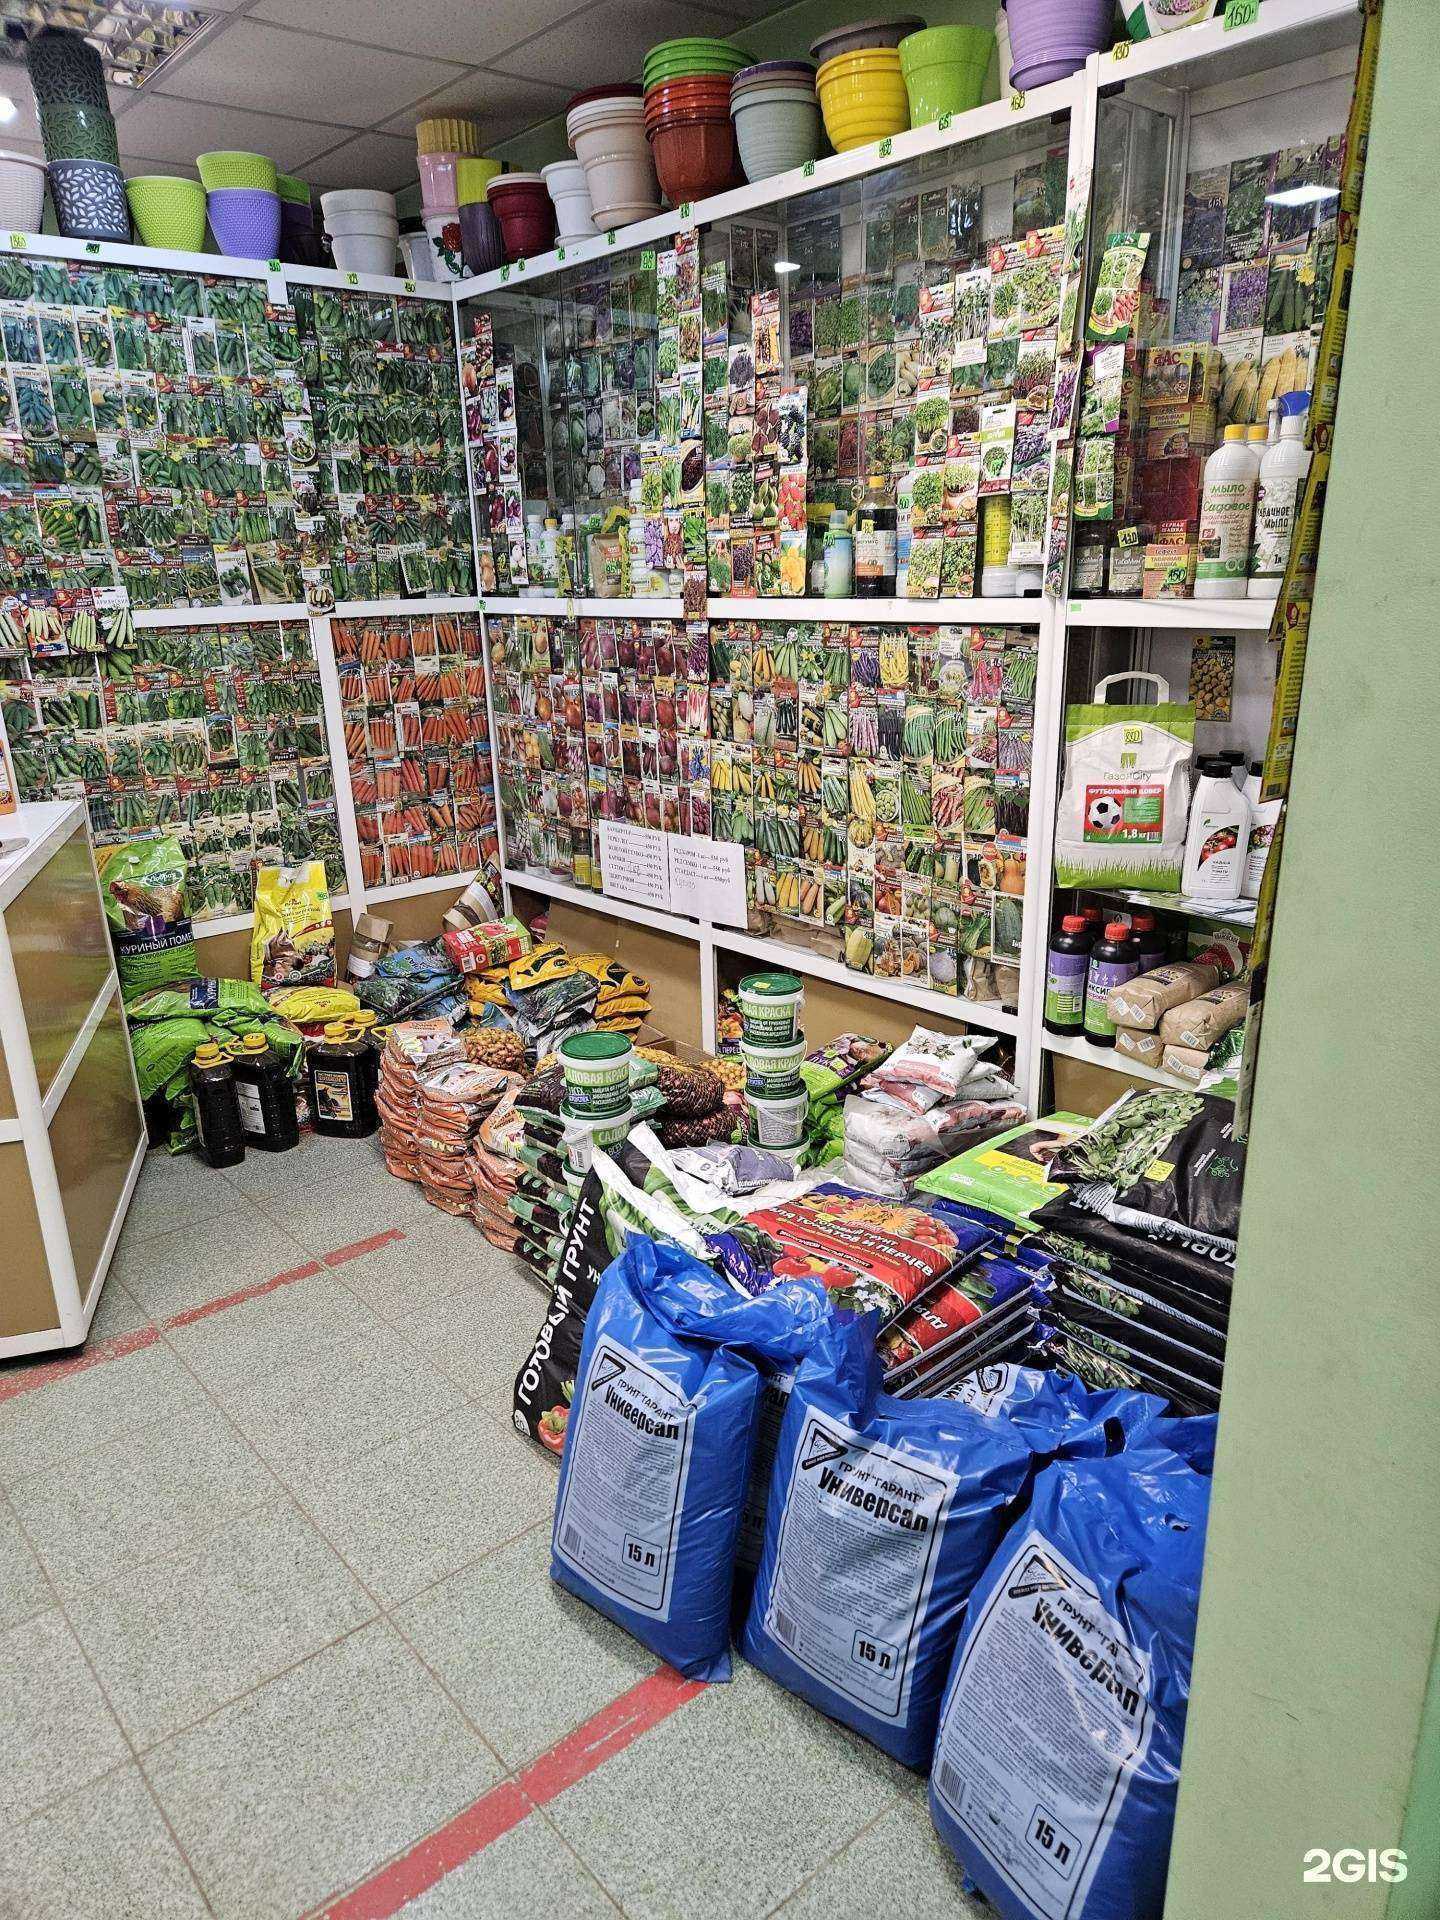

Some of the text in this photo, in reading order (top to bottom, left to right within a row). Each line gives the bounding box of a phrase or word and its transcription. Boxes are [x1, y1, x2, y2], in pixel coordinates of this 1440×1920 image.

[120, 938, 168, 955] КУРИНЫЙ
[168, 931, 194, 944] ПОМЕ
[599, 1125, 628, 1142] САДОВ
[876, 1243, 935, 1278] ПЕРЦЕВ
[518, 1197, 595, 1405] ГОТОВЫЙ ГРУНТ
[617, 1378, 642, 1399] ГРУНТ
[604, 1384, 679, 1440] Универсал
[838, 1461, 871, 1483] ГРУНТ
[817, 1467, 930, 1533] Универсал
[627, 1541, 643, 1562] 15
[1057, 1597, 1096, 1636] ГРУНТ
[858, 1640, 876, 1662] 15
[1032, 1597, 1140, 1716] Универсал
[1034, 1818, 1056, 1850] 15
